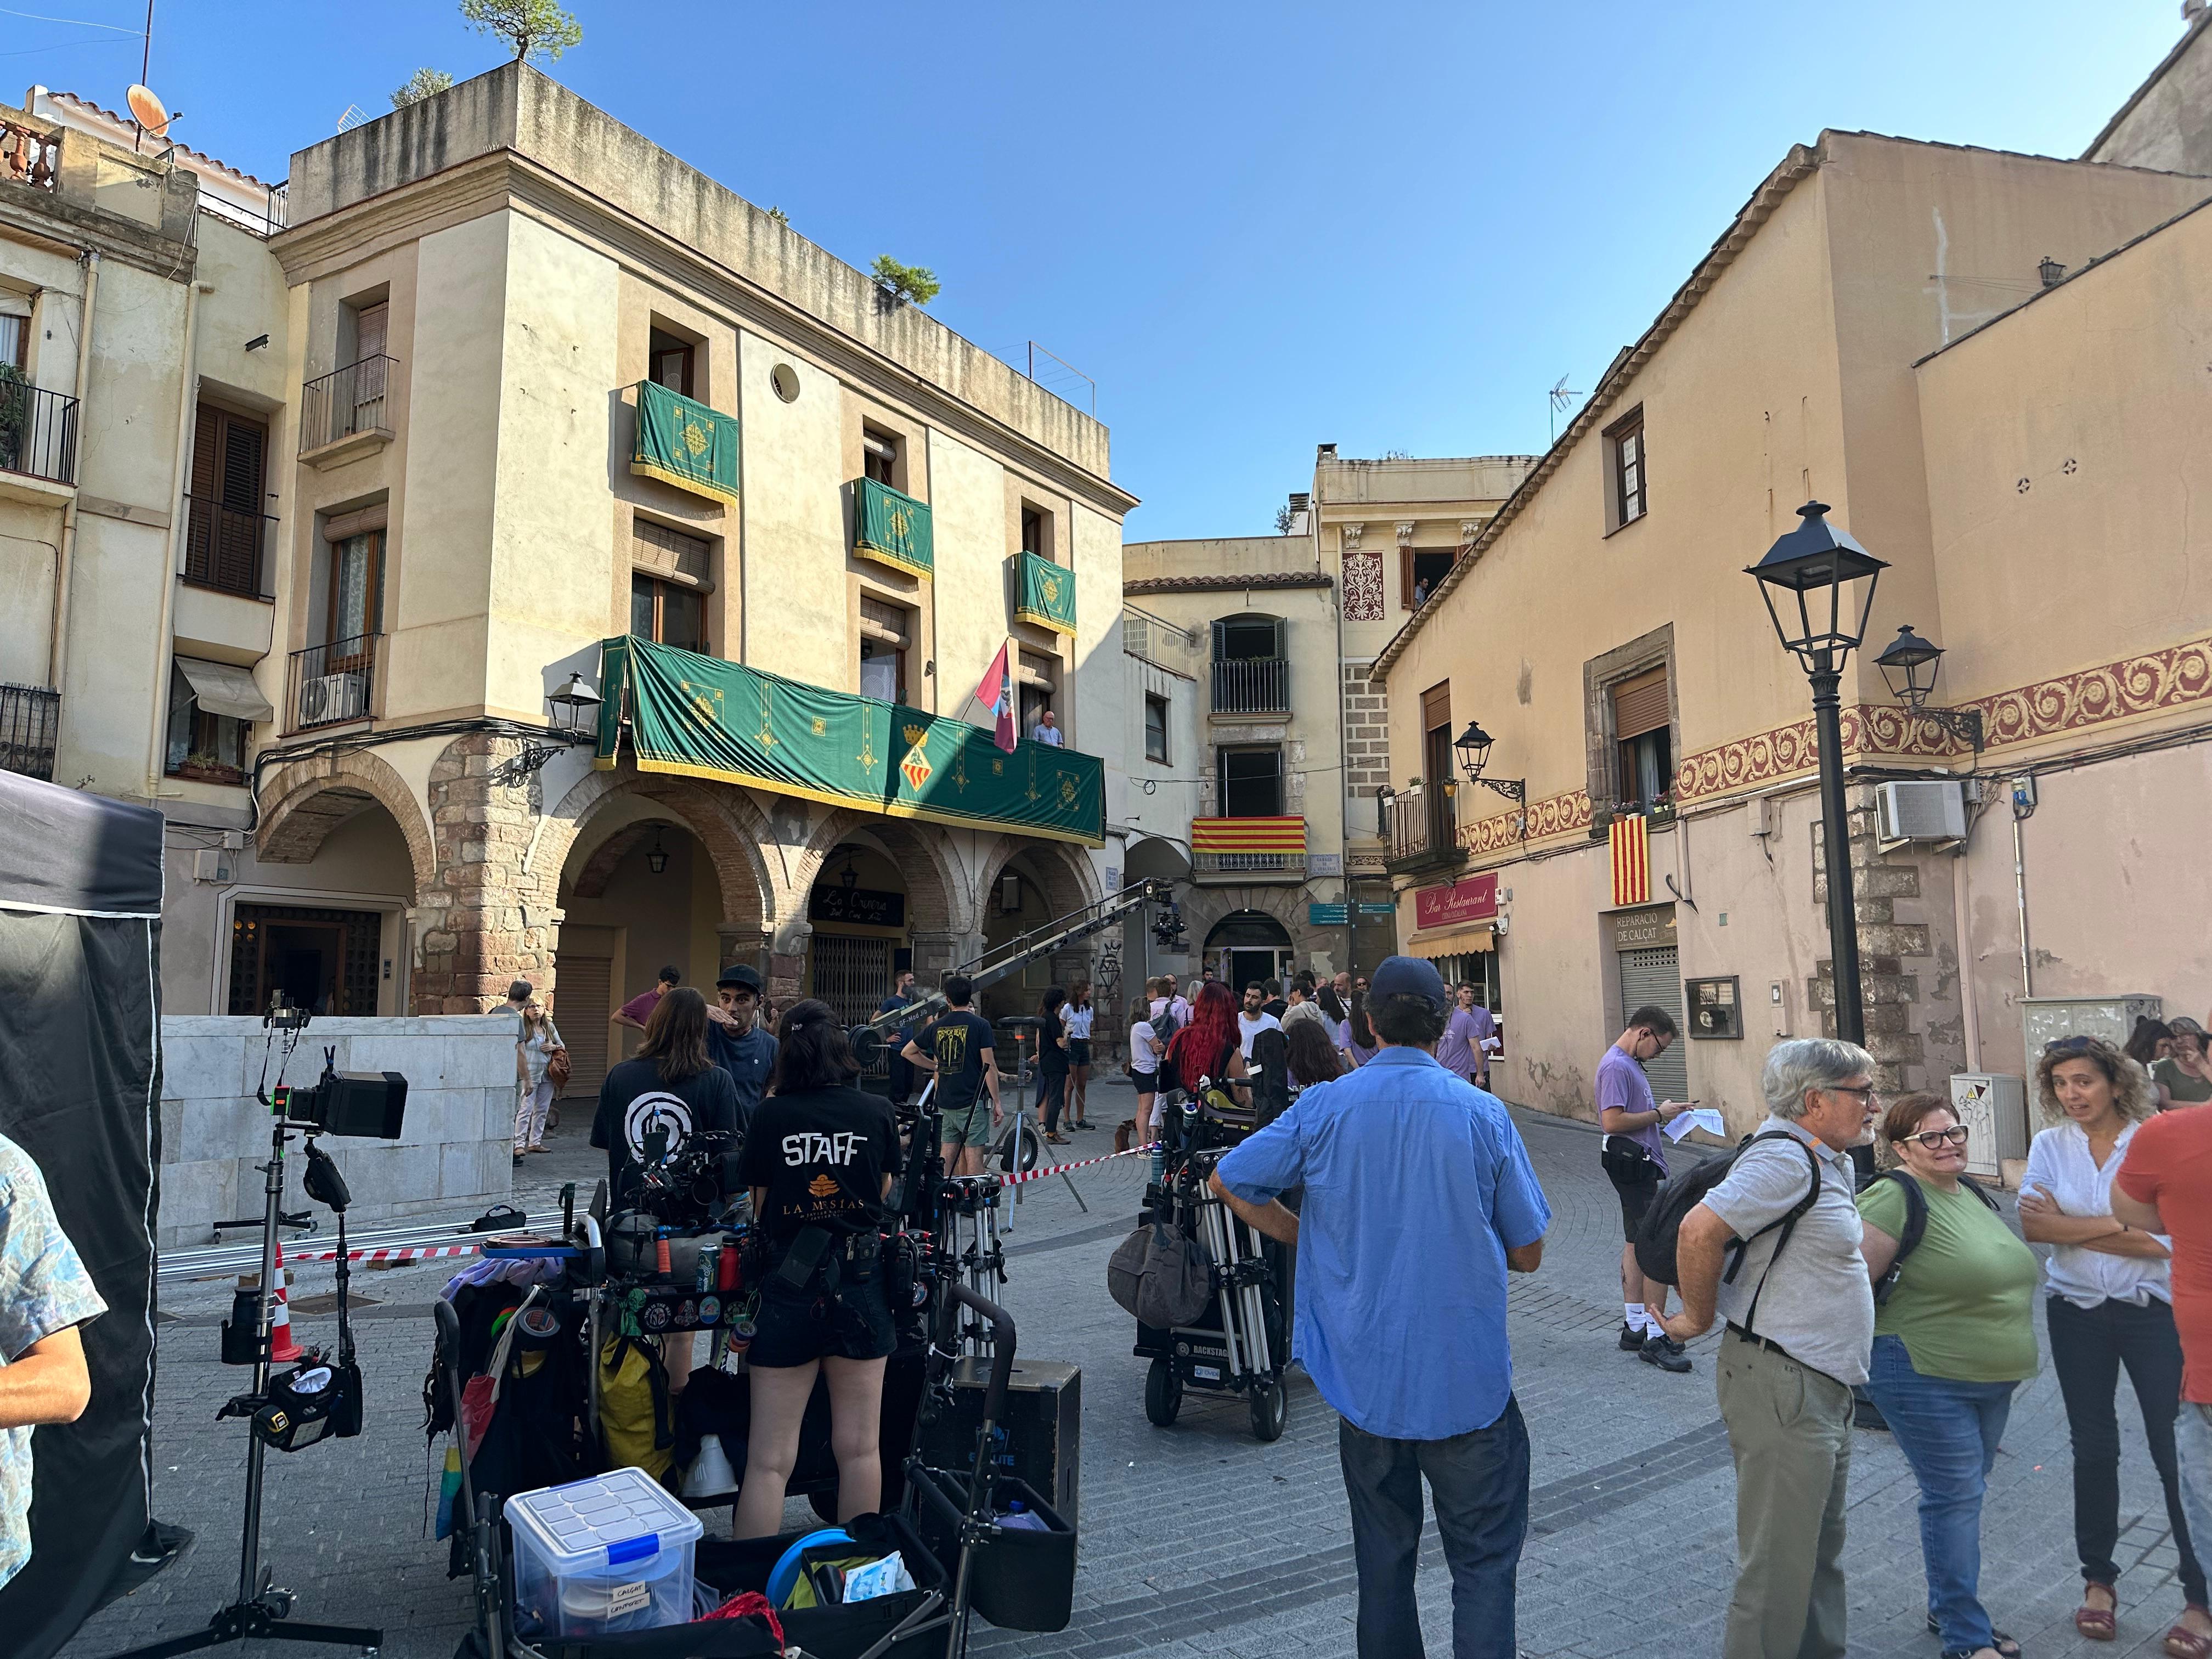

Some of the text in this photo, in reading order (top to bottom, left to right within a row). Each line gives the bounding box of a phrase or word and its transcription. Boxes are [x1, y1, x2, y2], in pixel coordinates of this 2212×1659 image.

[822, 889, 843, 906] La
[1425, 887, 1488, 915] Bar Restaurant
[1618, 931, 1628, 942] DE
[1629, 928, 1656, 942] CALÇAT
[899, 1012, 919, 1027] GF-Mod
[782, 1132, 868, 1166] STAFF
[783, 1204, 803, 1215] LA
